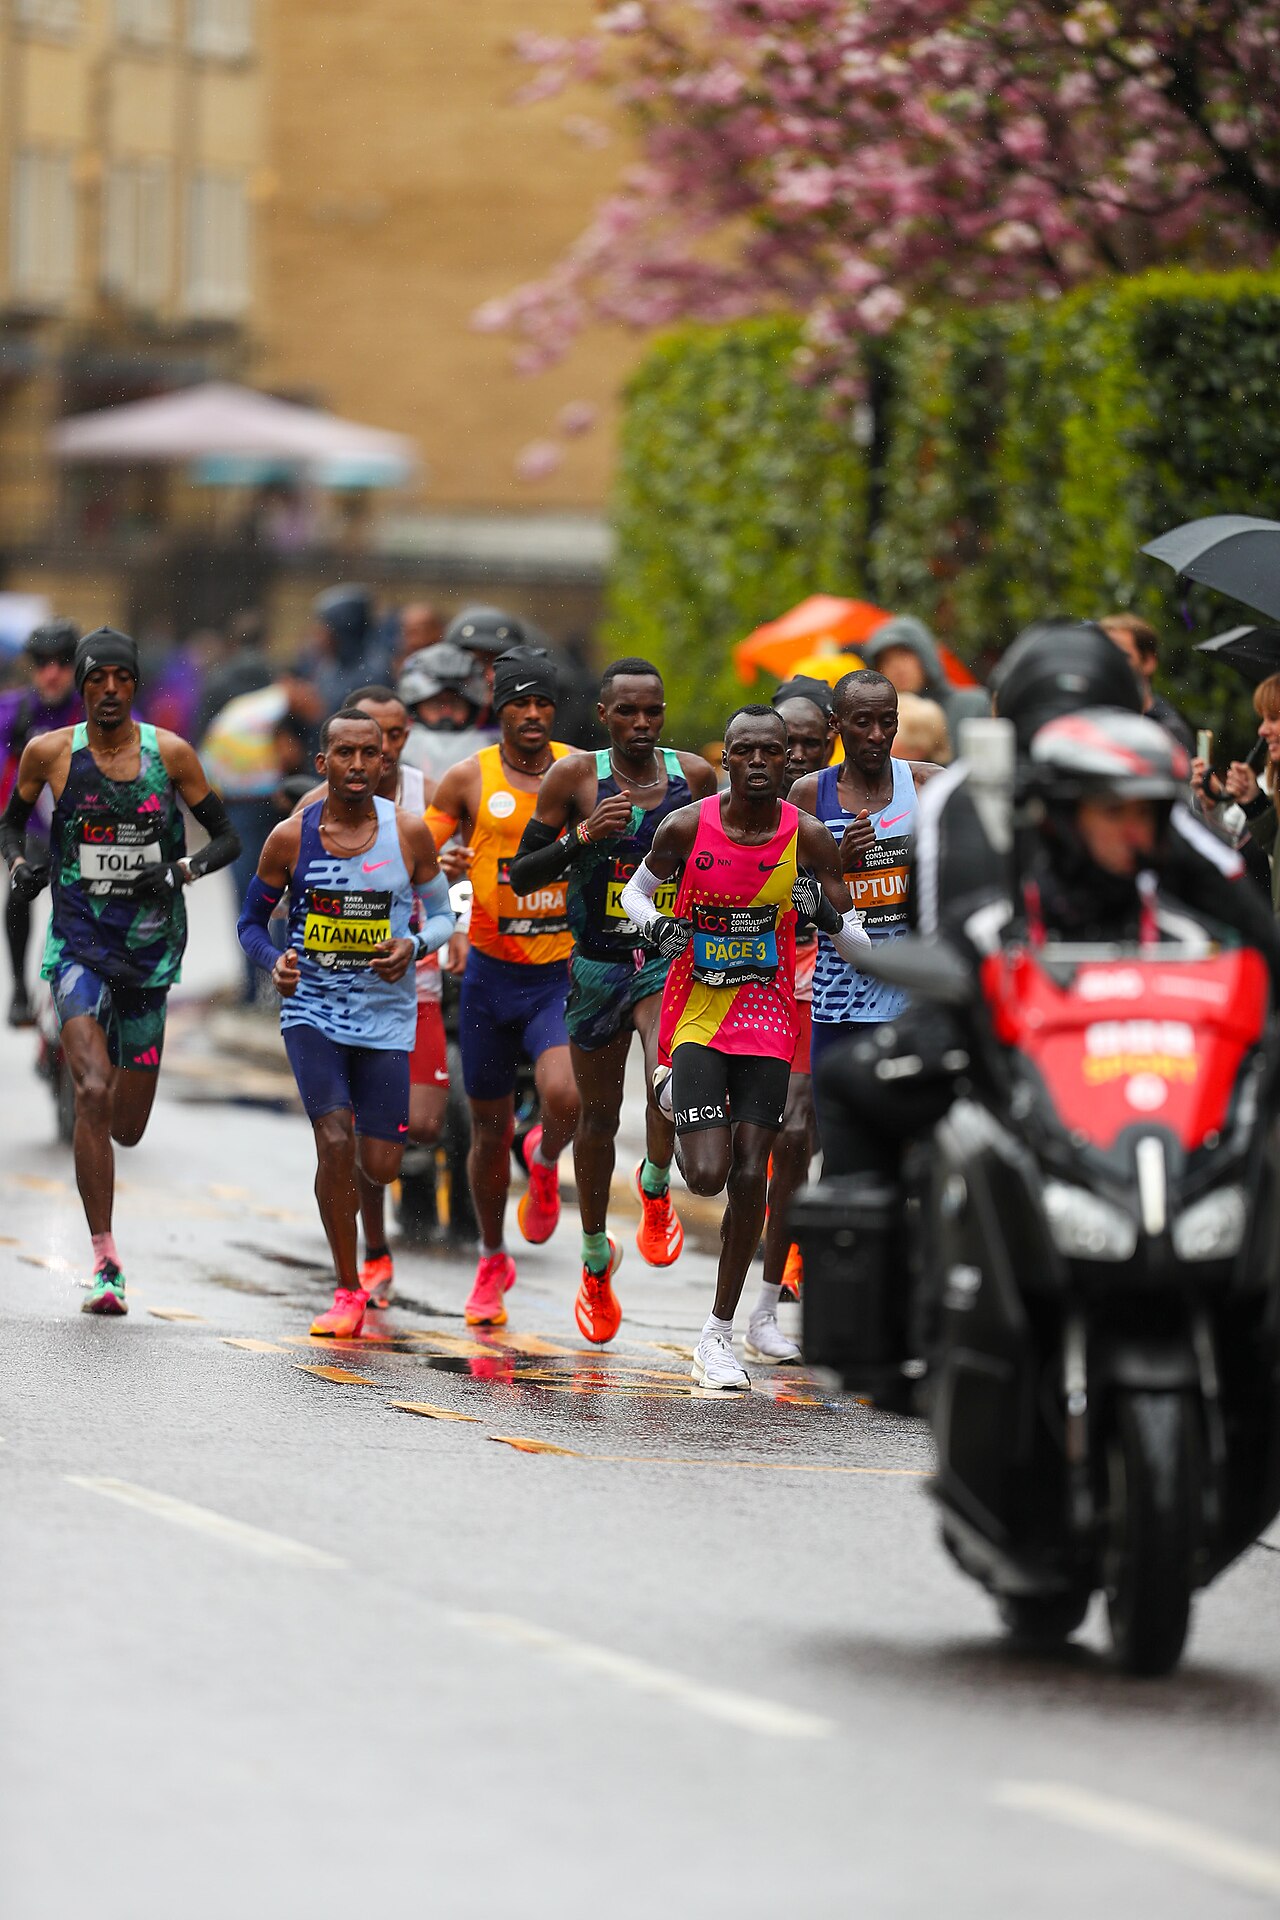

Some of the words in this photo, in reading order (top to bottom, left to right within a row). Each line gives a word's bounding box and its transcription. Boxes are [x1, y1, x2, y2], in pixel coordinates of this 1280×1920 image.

[84, 821, 115, 843] tcs
[96, 854, 145, 871] TOLA
[865, 848, 909, 860] CONSULTANCY
[866, 857, 894, 867] SERVICES
[614, 857, 636, 879] tc
[845, 873, 910, 900] IPTUM
[312, 893, 341, 915] tcs
[513, 890, 564, 911] TURA
[343, 909, 372, 917] SERVICES
[697, 911, 728, 933] tcs
[730, 915, 773, 926] CONSULTANCY
[867, 915, 884, 924] new
[308, 923, 387, 945] ATANAW
[731, 925, 760, 933] SERVICES
[705, 941, 753, 962] PACE
[755, 941, 767, 961] 3
[726, 975, 741, 984] new
[674, 1105, 724, 1126] INEOS
